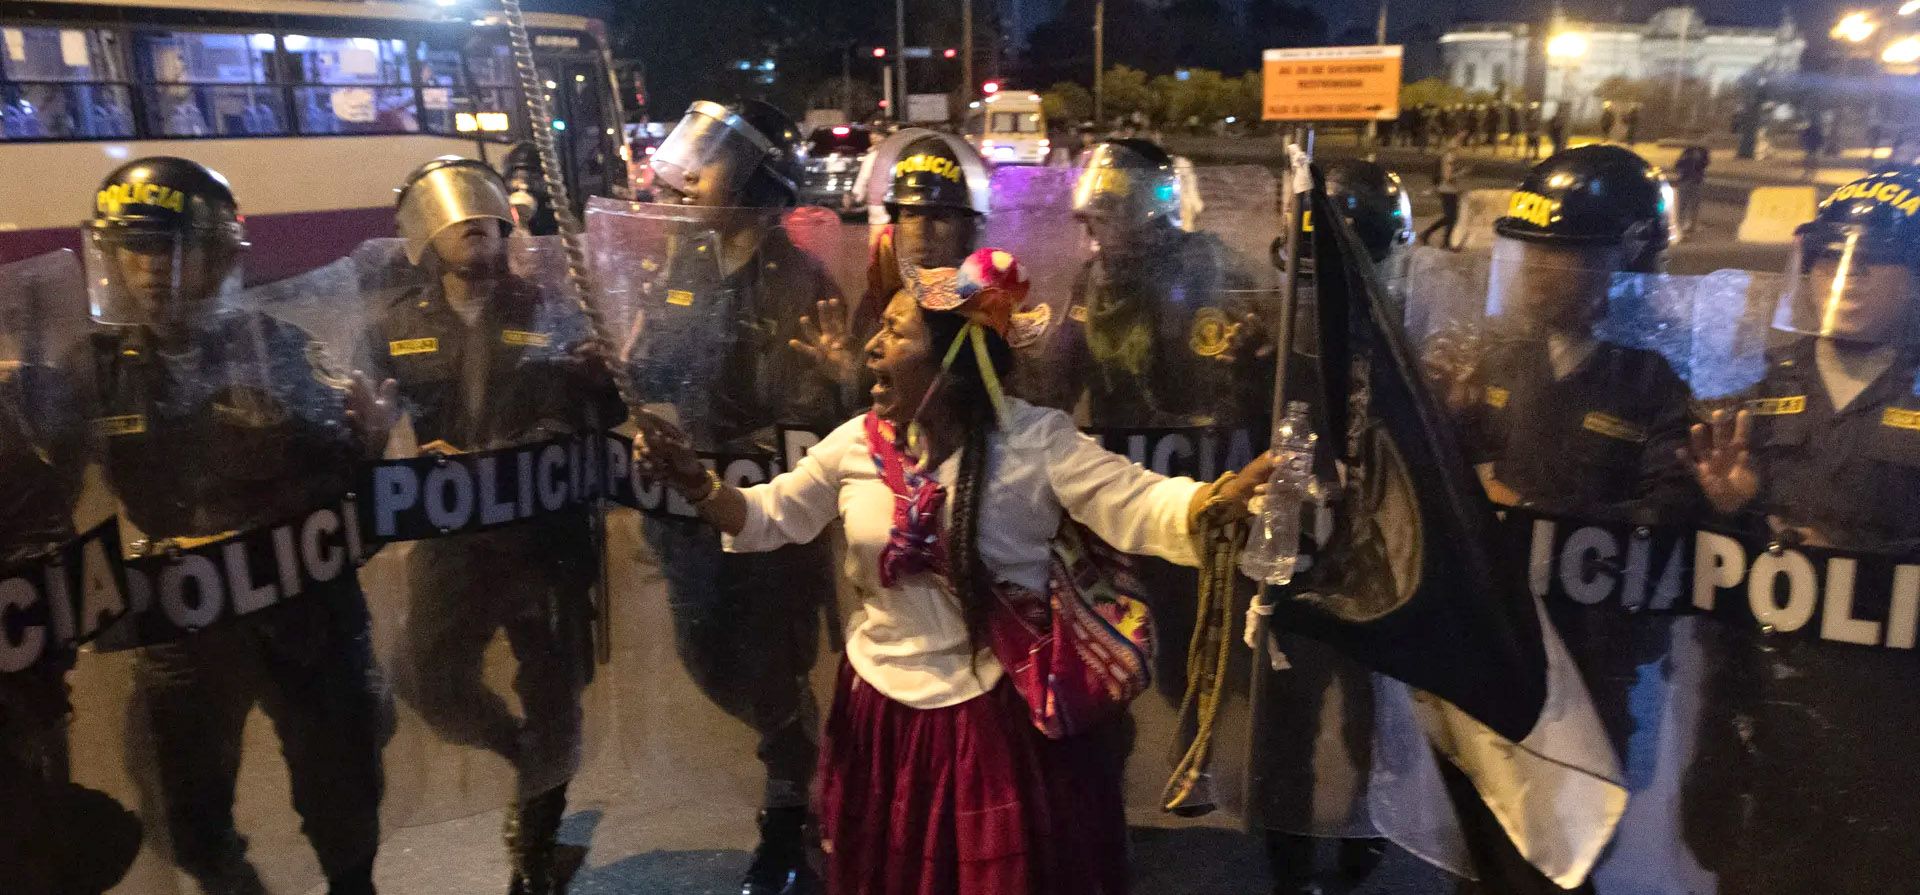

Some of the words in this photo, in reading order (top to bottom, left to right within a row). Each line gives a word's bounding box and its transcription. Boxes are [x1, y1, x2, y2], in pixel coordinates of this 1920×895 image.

[896, 153, 961, 183] POLICIA
[97, 182, 185, 213] POLICIA
[1692, 530, 1920, 649] POLI
